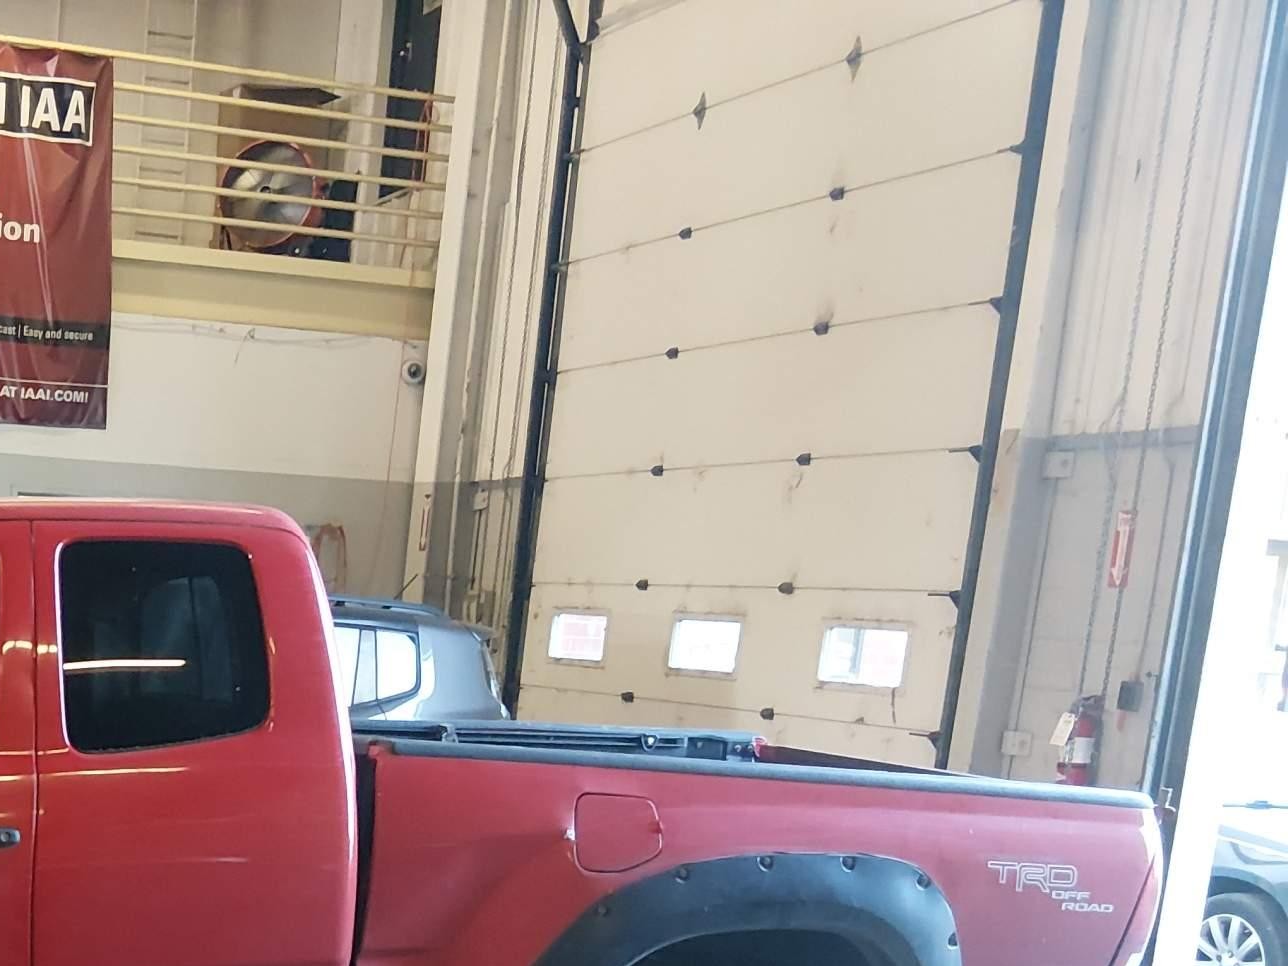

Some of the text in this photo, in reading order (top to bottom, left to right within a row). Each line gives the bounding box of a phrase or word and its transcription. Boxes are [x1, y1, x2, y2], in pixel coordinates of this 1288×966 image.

[19, 85, 86, 133] IAA
[23, 327, 44, 342] Easy
[45, 328, 62, 340] and
[64, 331, 94, 342] secure
[0, 384, 18, 399] AT
[20, 387, 89, 404] IAAI.COM!
[987, 860, 1078, 893] TRD
[1051, 890, 1092, 901] OFF
[1062, 902, 1114, 913] ROAD
